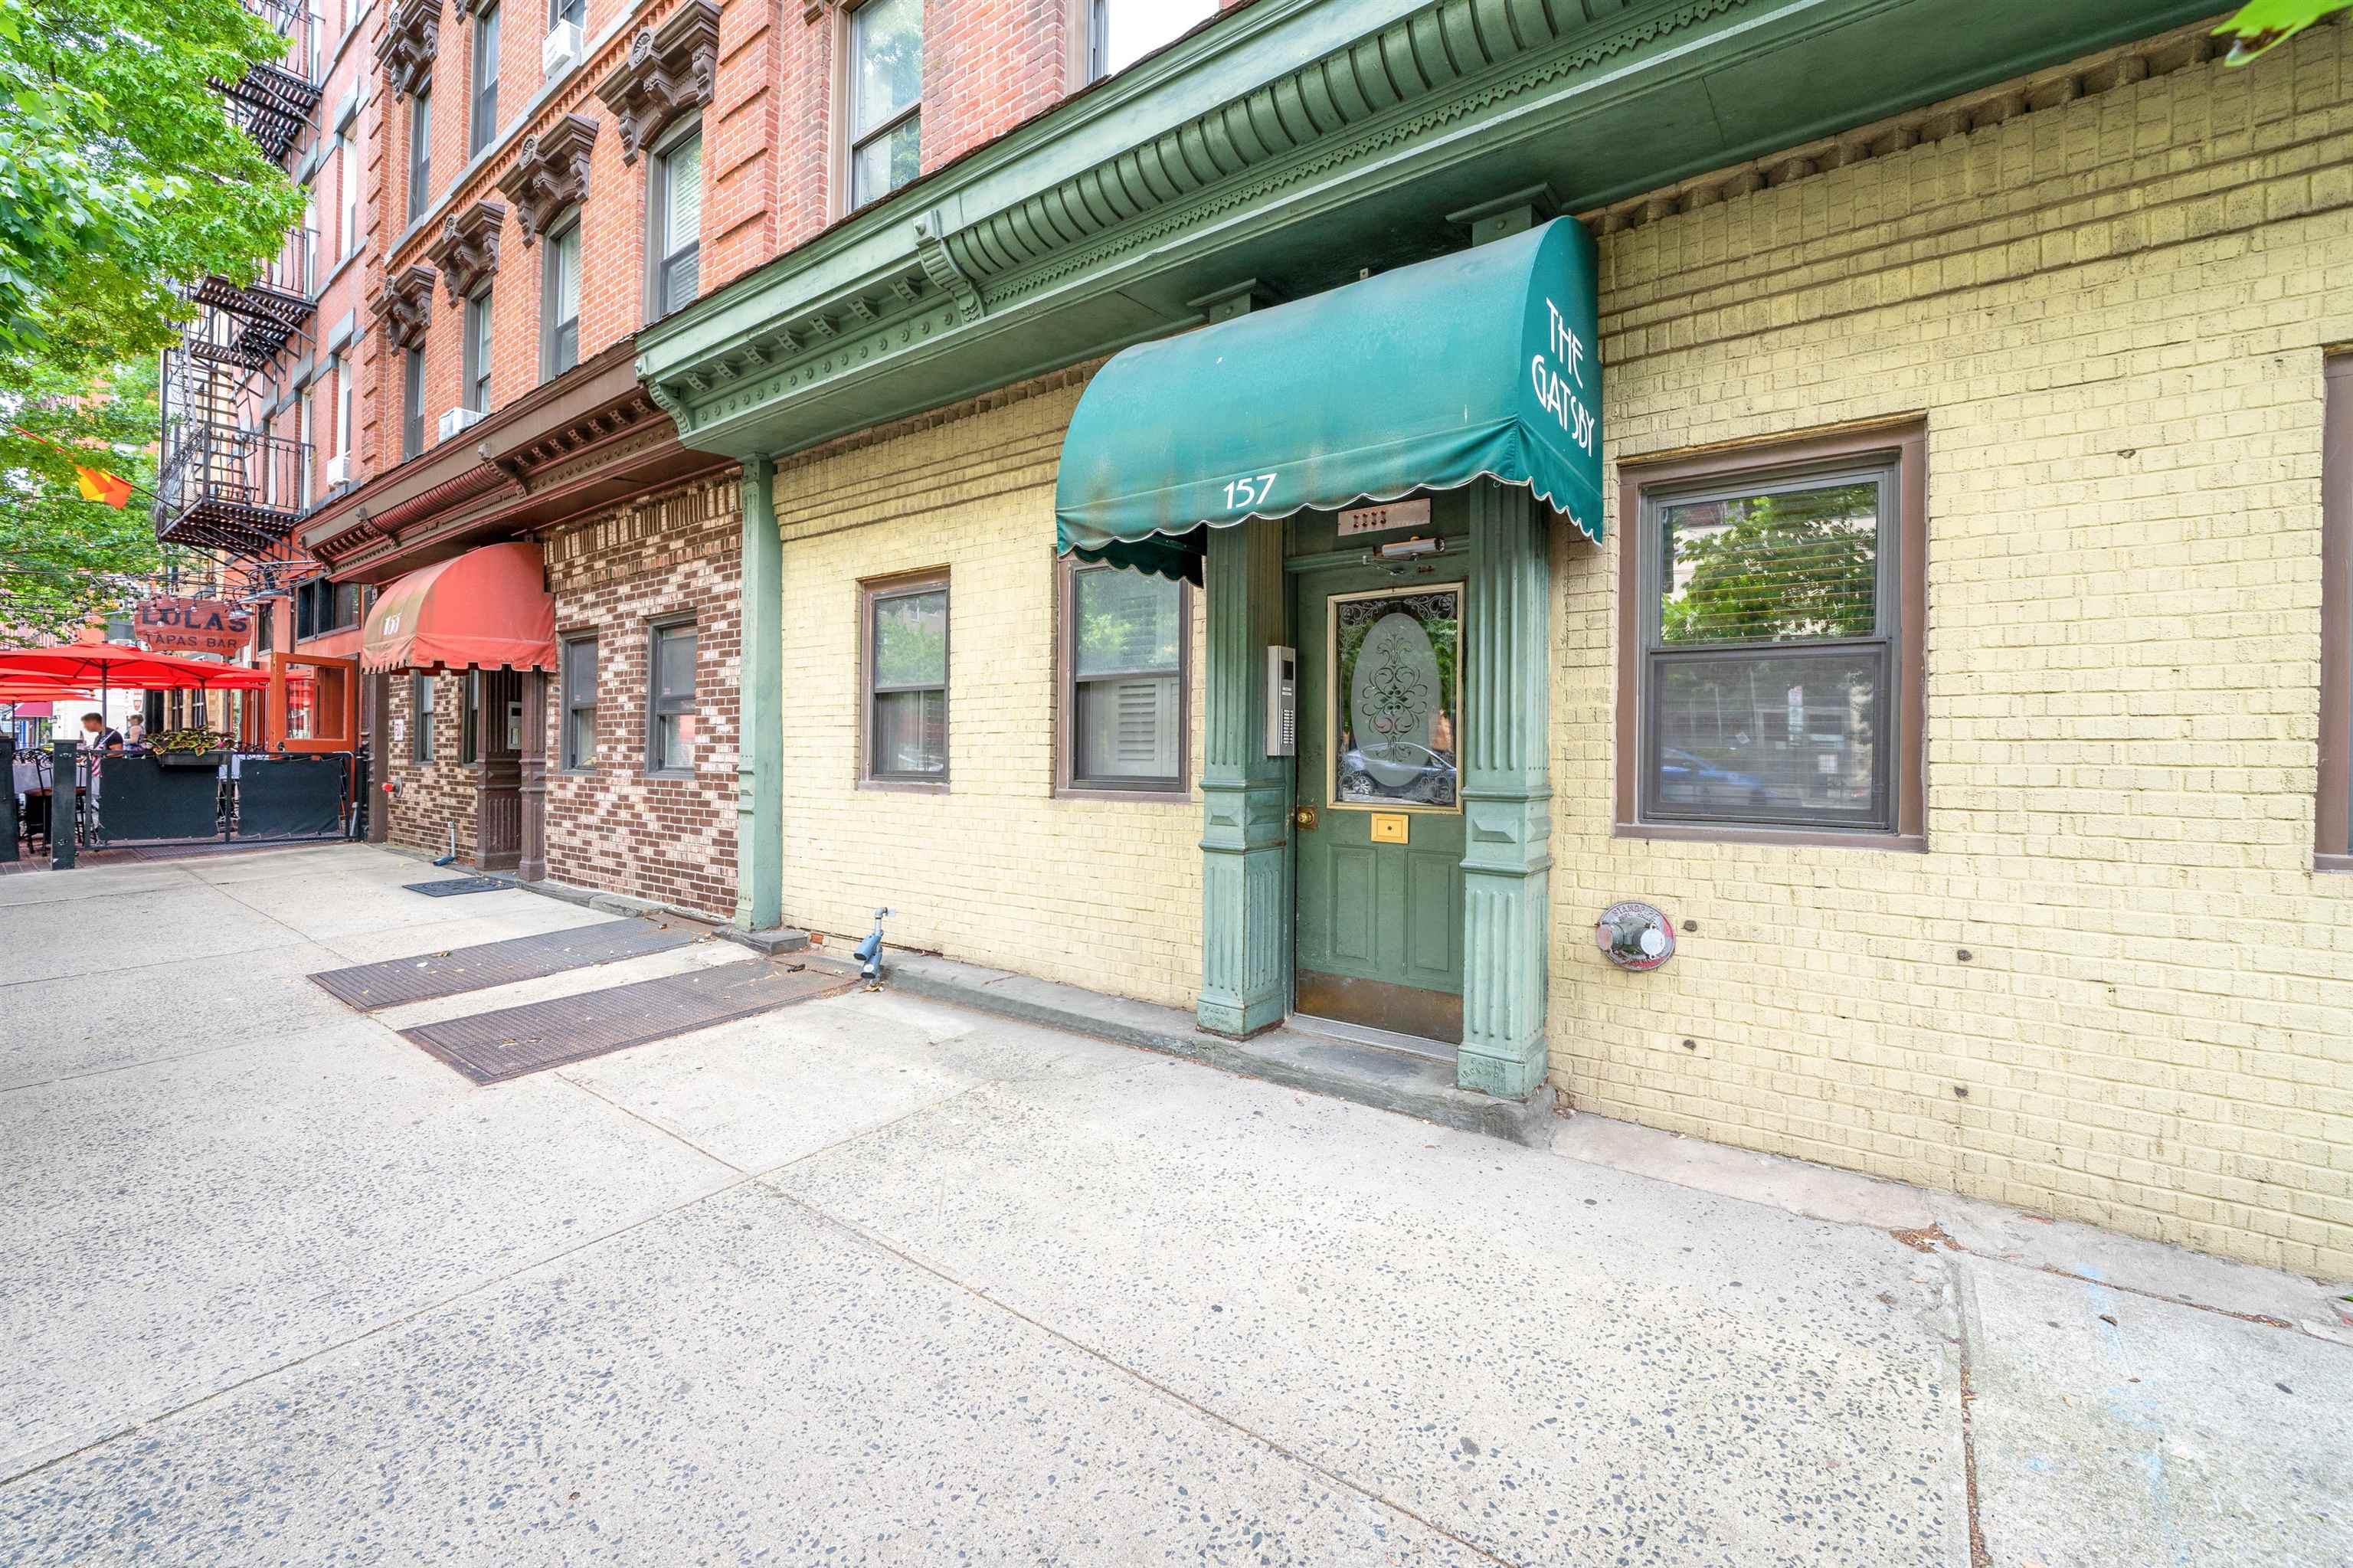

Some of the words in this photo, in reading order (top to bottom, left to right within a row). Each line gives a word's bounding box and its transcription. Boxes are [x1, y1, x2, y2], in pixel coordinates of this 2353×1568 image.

[1546, 296, 1583, 389] THE
[1532, 355, 1595, 457] GATSBY
[1222, 473, 1278, 509] 157
[145, 632, 198, 647] TAPAS
[207, 637, 237, 649] BAR
